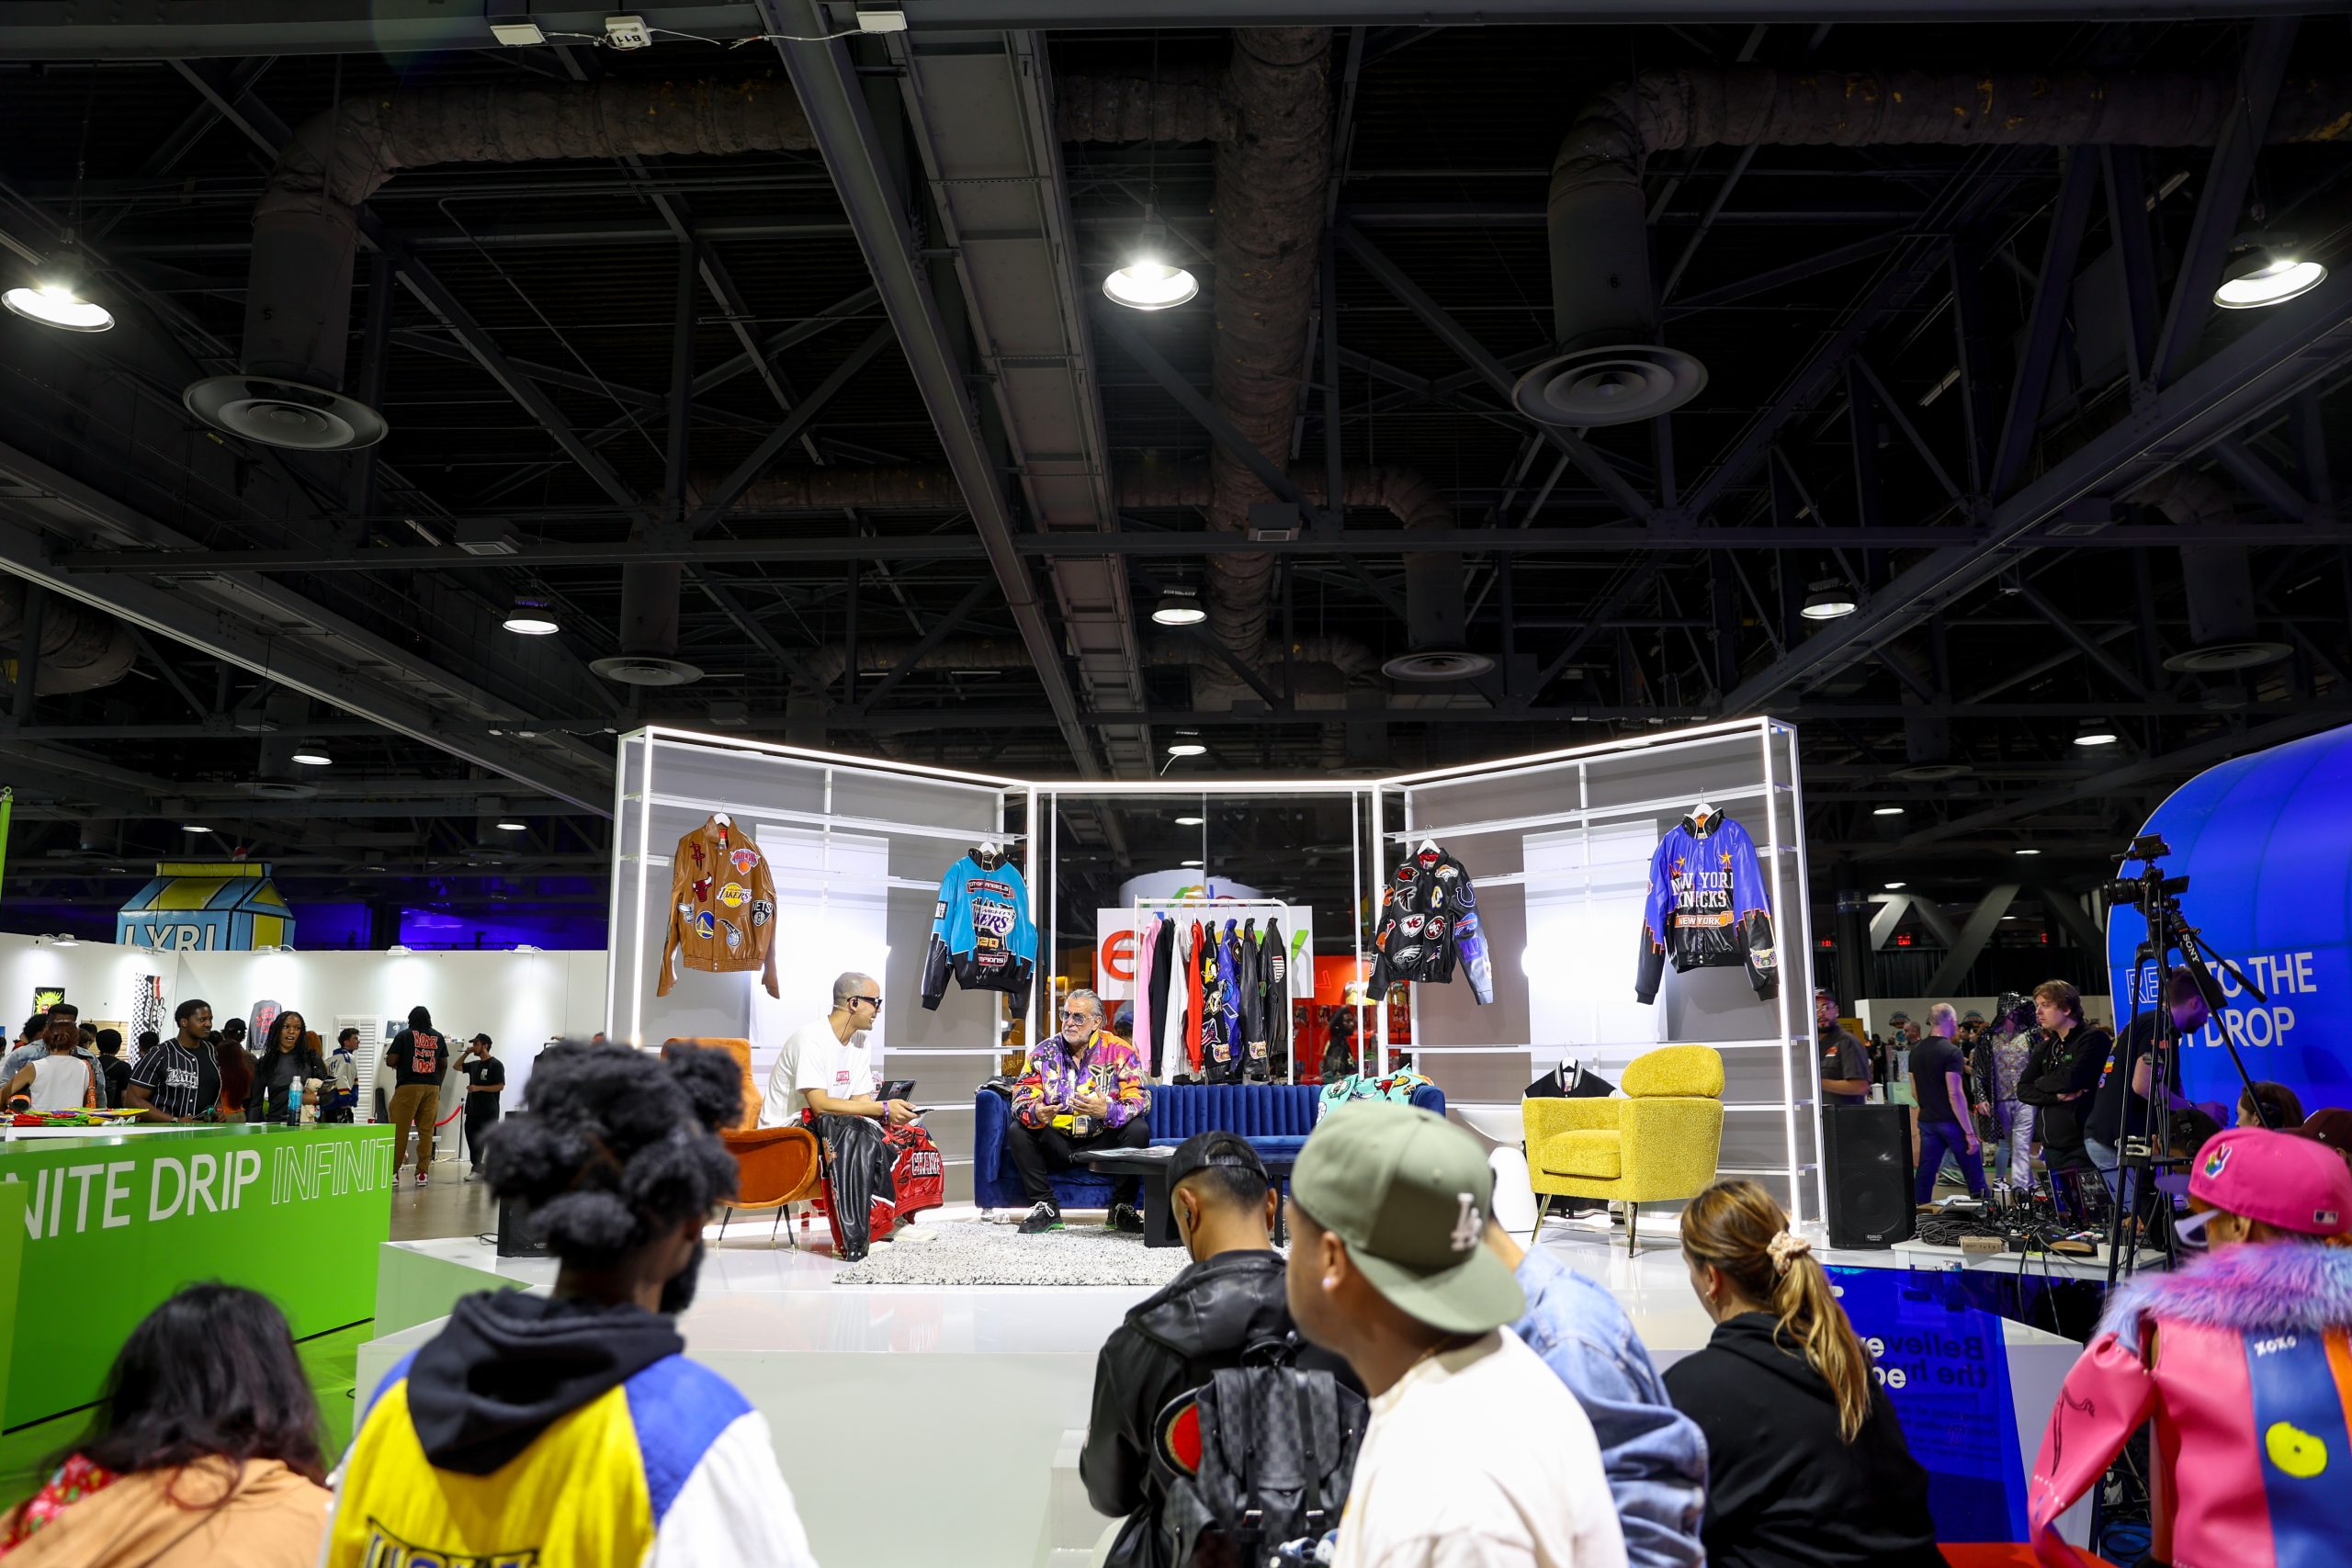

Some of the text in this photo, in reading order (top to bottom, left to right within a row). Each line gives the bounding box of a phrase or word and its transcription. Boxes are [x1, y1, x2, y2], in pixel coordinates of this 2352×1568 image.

[974, 912, 1010, 934] ERS
[1697, 918, 1721, 926] YORK
[2182, 933, 2199, 963] SONY
[2248, 952, 2317, 995] THE
[412, 1030, 437, 1050] BOYZ
[2204, 1007, 2295, 1048] DROP
[148, 1149, 261, 1222] DRIP
[272, 1138, 395, 1204] INFINIT
[1451, 1192, 1483, 1251] LA
[2254, 1336, 2297, 1357] XOXO
